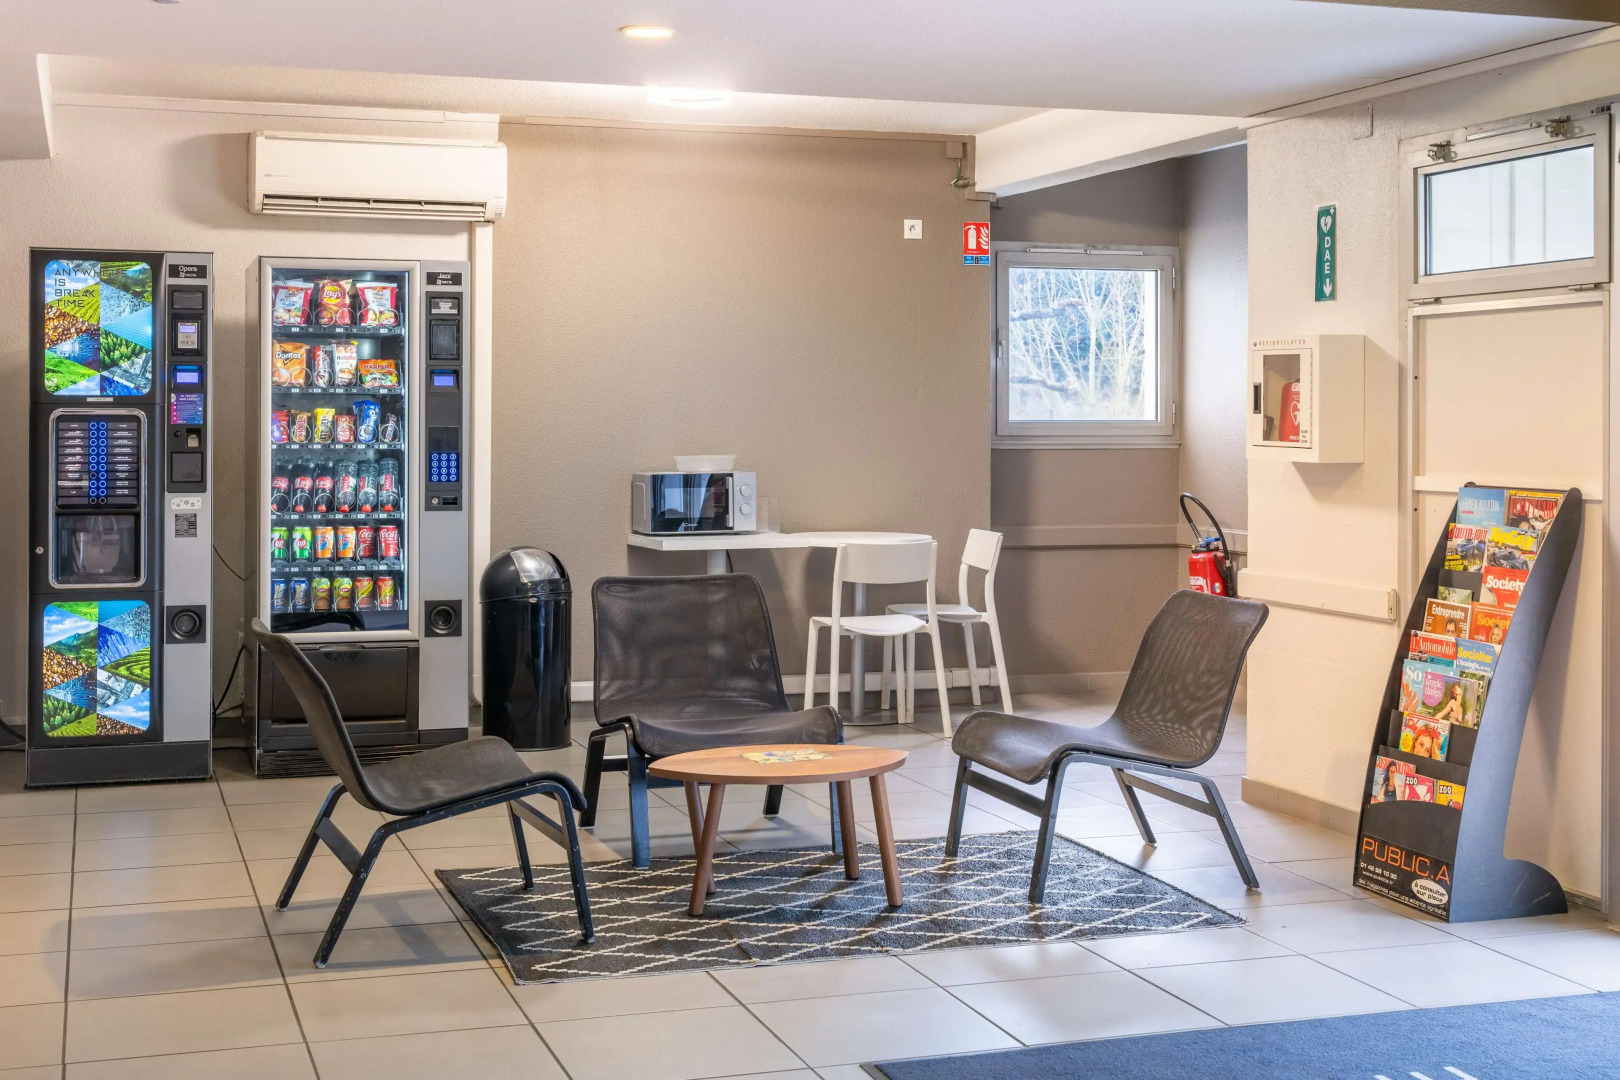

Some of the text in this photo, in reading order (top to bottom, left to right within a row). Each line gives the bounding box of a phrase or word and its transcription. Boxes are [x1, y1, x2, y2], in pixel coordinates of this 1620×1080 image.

[54, 268, 128, 278] ANYWHERE
[178, 265, 198, 273] Opera
[54, 278, 66, 287] IS
[54, 288, 96, 298] BREAK
[323, 289, 342, 299] Lay's
[56, 299, 85, 308] TIME
[275, 351, 303, 360] Doritos
[363, 363, 390, 371] HARIBO
[1431, 603, 1466, 620] Entreprendre
[1411, 637, 1456, 656] L'Automobile
[1457, 646, 1493, 664] Socialter
[1425, 679, 1443, 689] simple
[1424, 686, 1442, 699] things
[1405, 776, 1418, 785] ZOO
[1440, 785, 1452, 794] ZOO
[1362, 837, 1450, 885] PUBLIC.A
[1420, 884, 1446, 897] consulter
[1428, 893, 1443, 903] place
